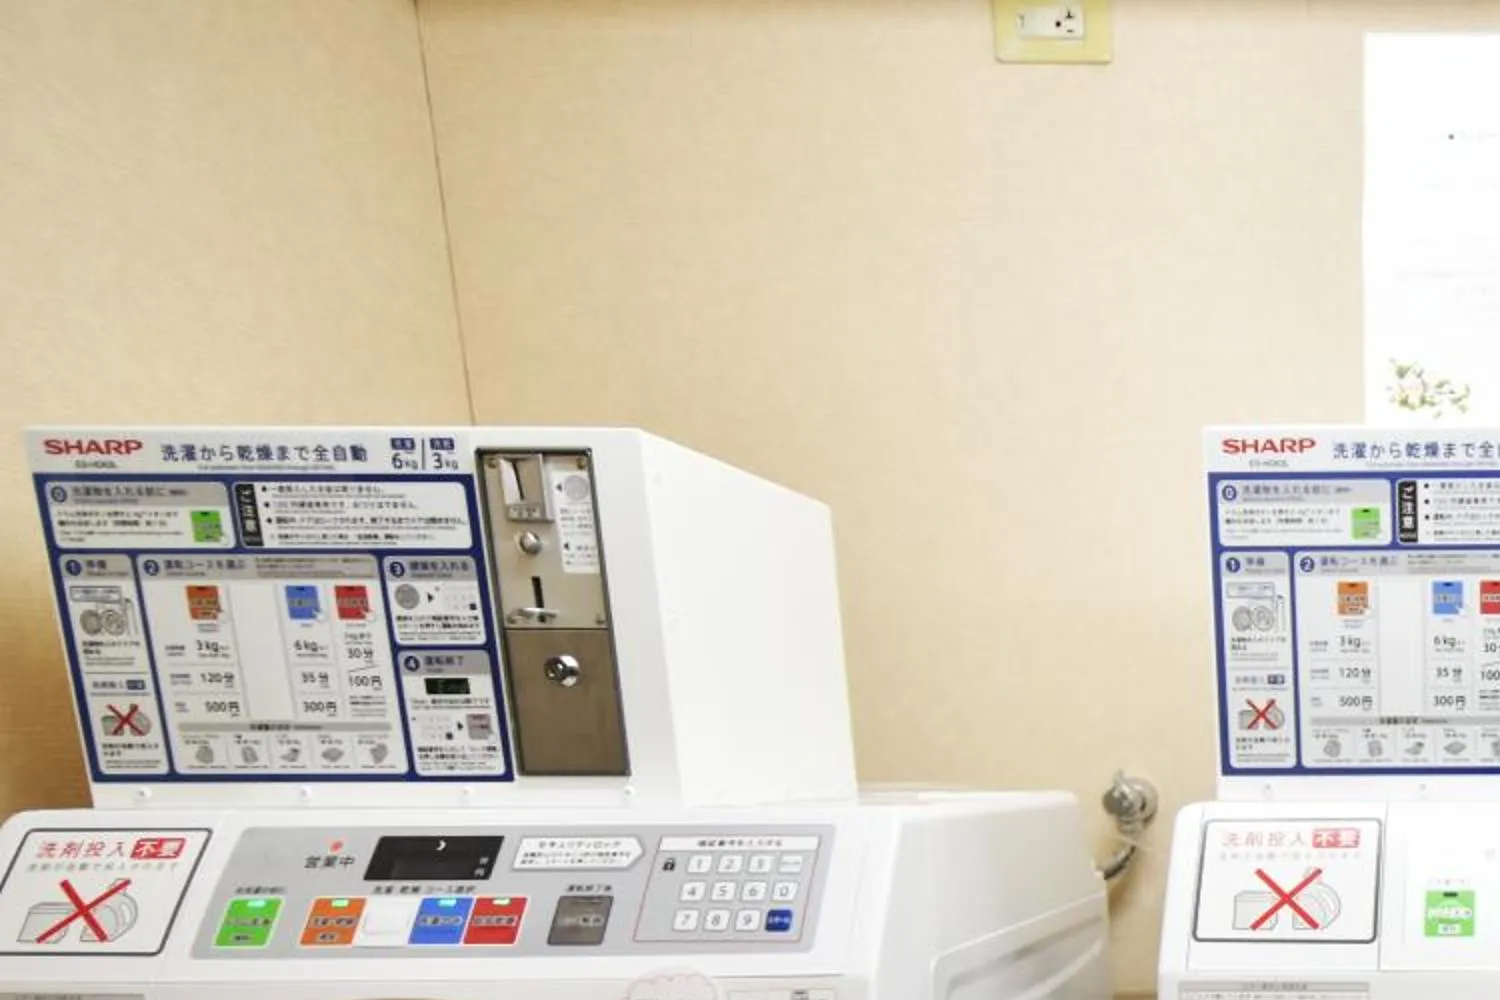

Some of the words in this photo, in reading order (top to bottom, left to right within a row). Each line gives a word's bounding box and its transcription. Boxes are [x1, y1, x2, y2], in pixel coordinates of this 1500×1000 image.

[44, 438, 143, 457] SHARP
[161, 443, 368, 464] 洗濯から乾燥まで全自動
[1222, 438, 1316, 454] SHARP
[1222, 829, 1306, 848] 洗剤投入
[36, 839, 126, 859] 洗剤投入
[133, 838, 184, 858] 不要
[304, 855, 356, 868] 営業中
